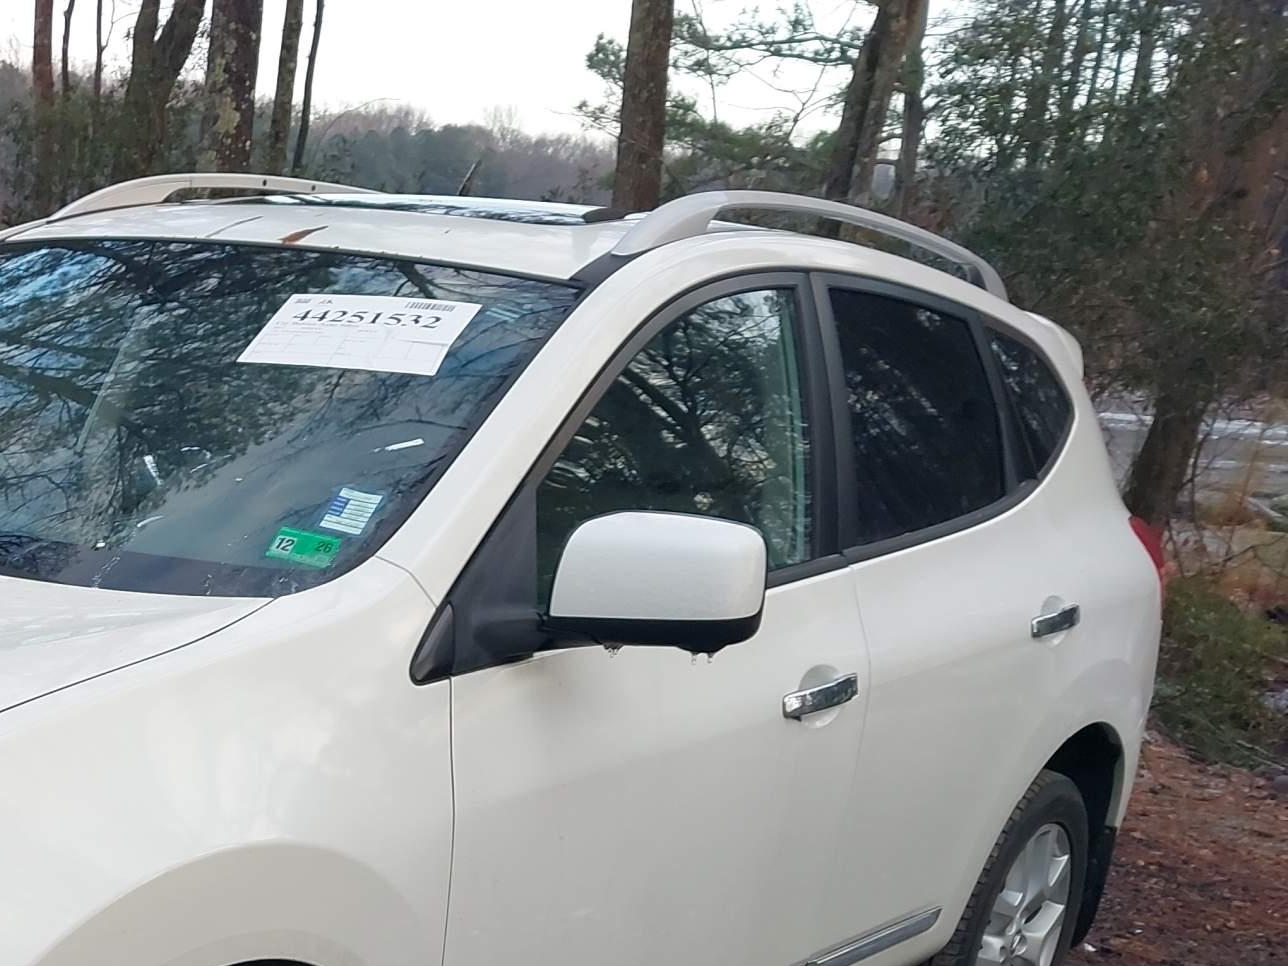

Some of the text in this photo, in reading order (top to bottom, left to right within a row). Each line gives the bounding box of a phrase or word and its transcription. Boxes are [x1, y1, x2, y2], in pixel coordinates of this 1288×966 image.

[292, 308, 442, 329] 44251532
[274, 537, 333, 554] 12 26
